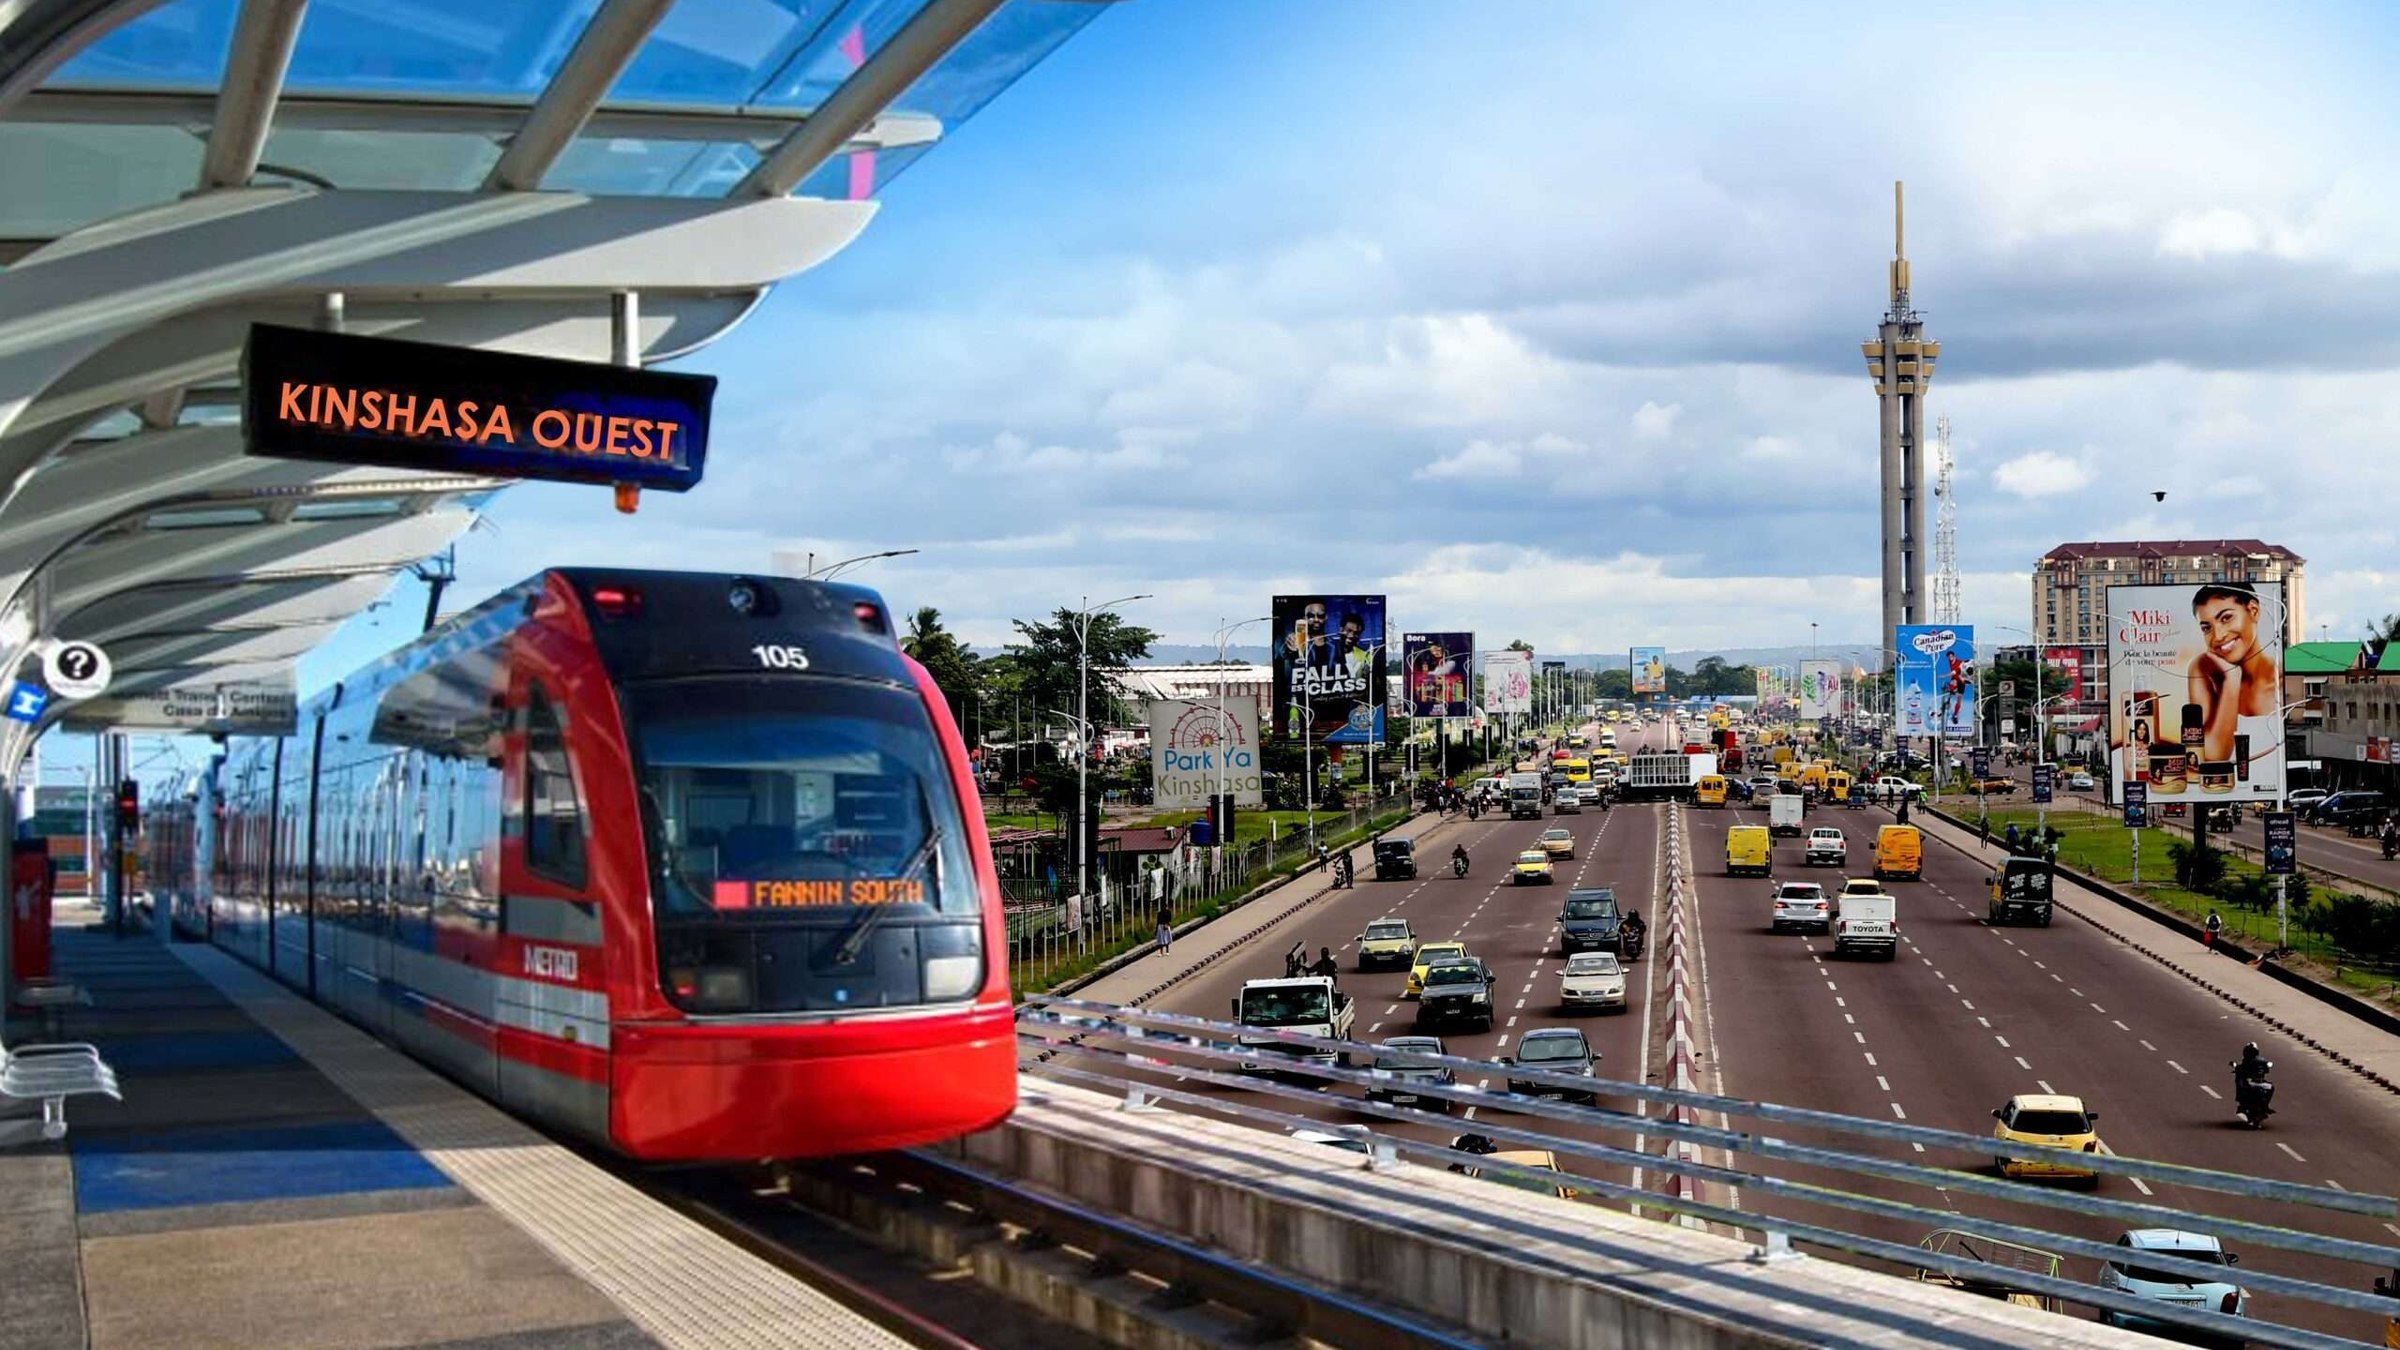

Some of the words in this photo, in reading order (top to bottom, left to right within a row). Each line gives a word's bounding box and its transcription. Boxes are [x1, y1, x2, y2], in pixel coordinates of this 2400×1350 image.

[279, 382, 514, 443] KINSHASA
[532, 410, 678, 460] OUEST
[2128, 609, 2170, 625] Miki
[752, 644, 809, 669] 105
[1308, 678, 1367, 695] CLASS
[1165, 750, 1213, 771] Park
[1222, 746, 1251, 769] Ya
[1157, 772, 1261, 796] Kinshasa
[755, 880, 843, 907] FANNIN
[851, 880, 924, 904] SOUTH
